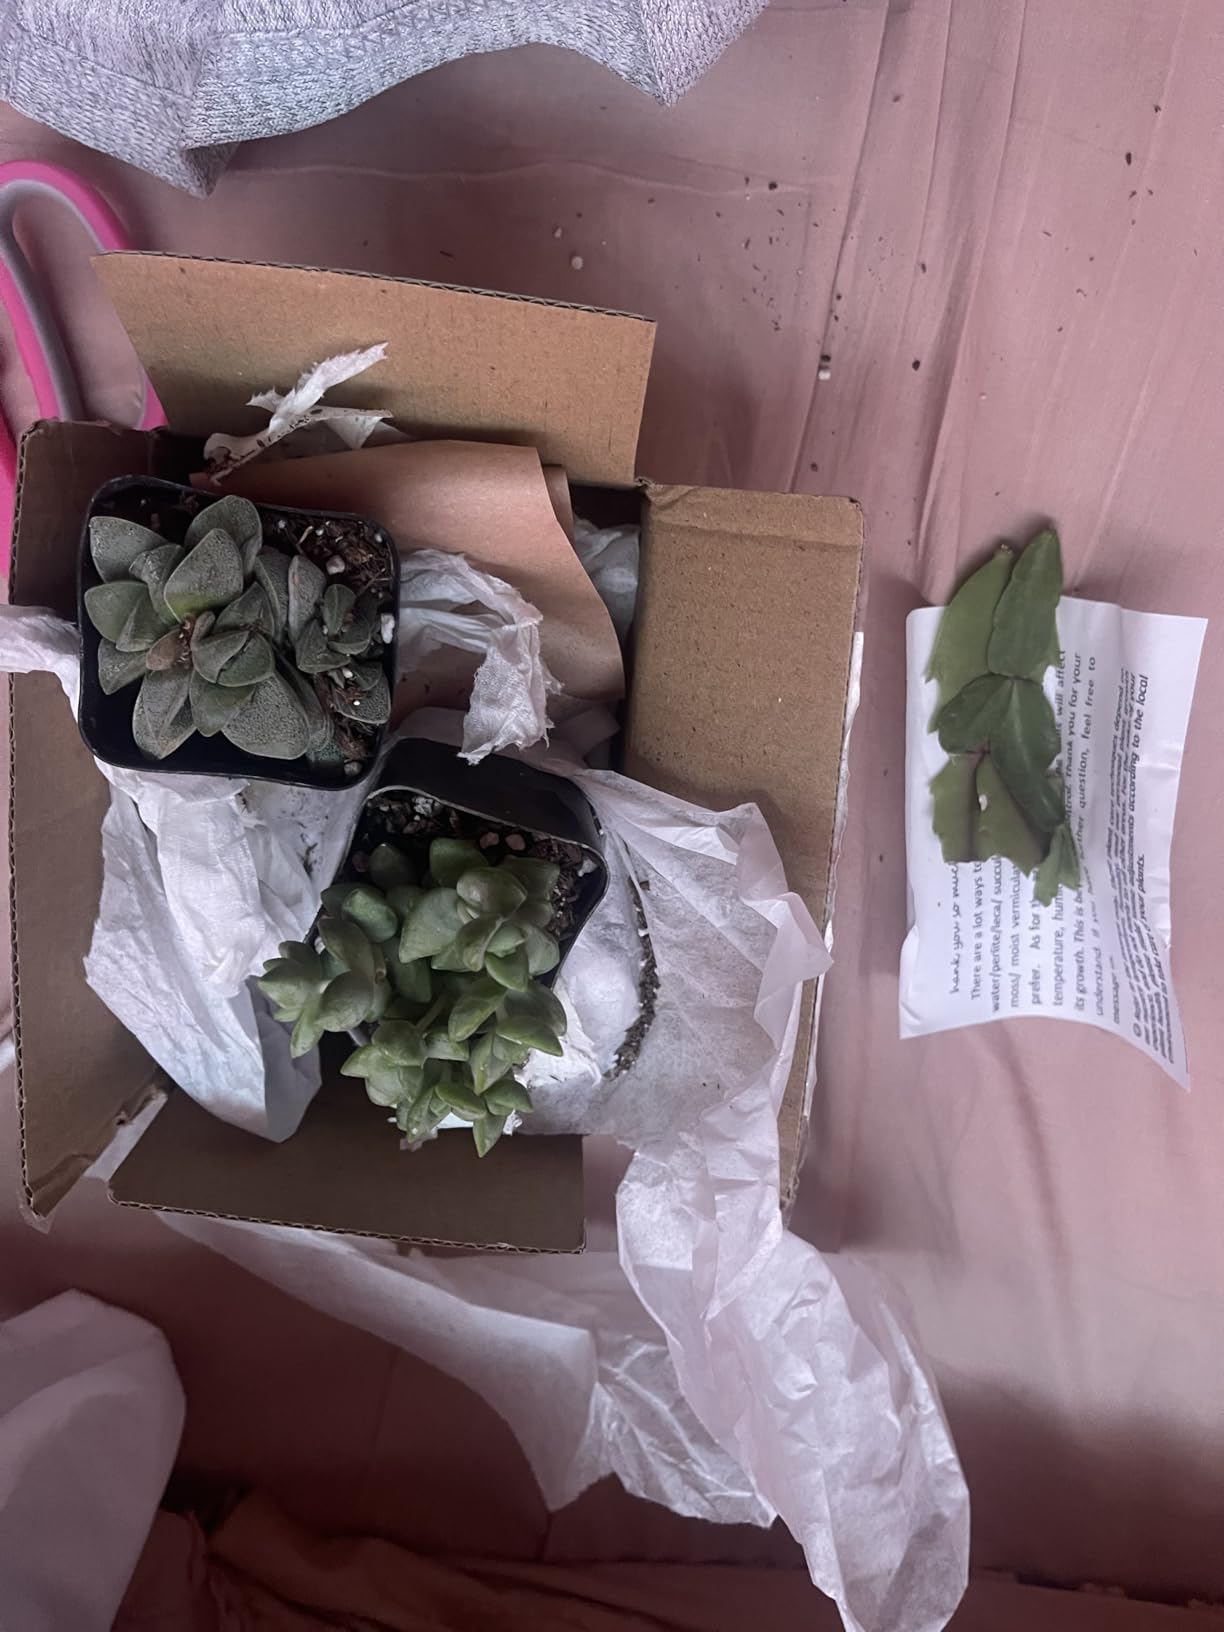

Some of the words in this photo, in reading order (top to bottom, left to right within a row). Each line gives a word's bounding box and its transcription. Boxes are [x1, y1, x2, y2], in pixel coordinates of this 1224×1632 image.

[1072, 653, 1081, 684] your
[1088, 657, 1096, 671] to
[1068, 690, 1078, 708] for
[1085, 680, 1094, 706] free
[1136, 674, 1148, 705] local
[1056, 694, 1064, 716] will
[1112, 686, 1124, 731] depend
[1068, 712, 1076, 736] you
[1081, 714, 1091, 740] feel
[1133, 710, 1144, 730] the
[1132, 735, 1140, 748] to
[1077, 748, 1090, 809] question,
[1127, 753, 1140, 811] according
[1136, 854, 1146, 893] plants.
[974, 877, 984, 906] ways
[954, 902, 961, 918] so
[973, 911, 983, 928] lot
[1029, 914, 1040, 930] for
[1074, 906, 1084, 916] is
[953, 922, 962, 950] you
[1030, 935, 1040, 950] As
[1074, 920, 1084, 942] This
[973, 944, 982, 962] are
[1010, 934, 1019, 966] moist
[1052, 927, 1065, 1006] temperature,
[1074, 949, 1087, 994] growth.
[971, 965, 982, 1000] There
[1009, 973, 1021, 1008] moss/
[1030, 965, 1042, 1005] prefer.
[1074, 997, 1084, 1010] its
